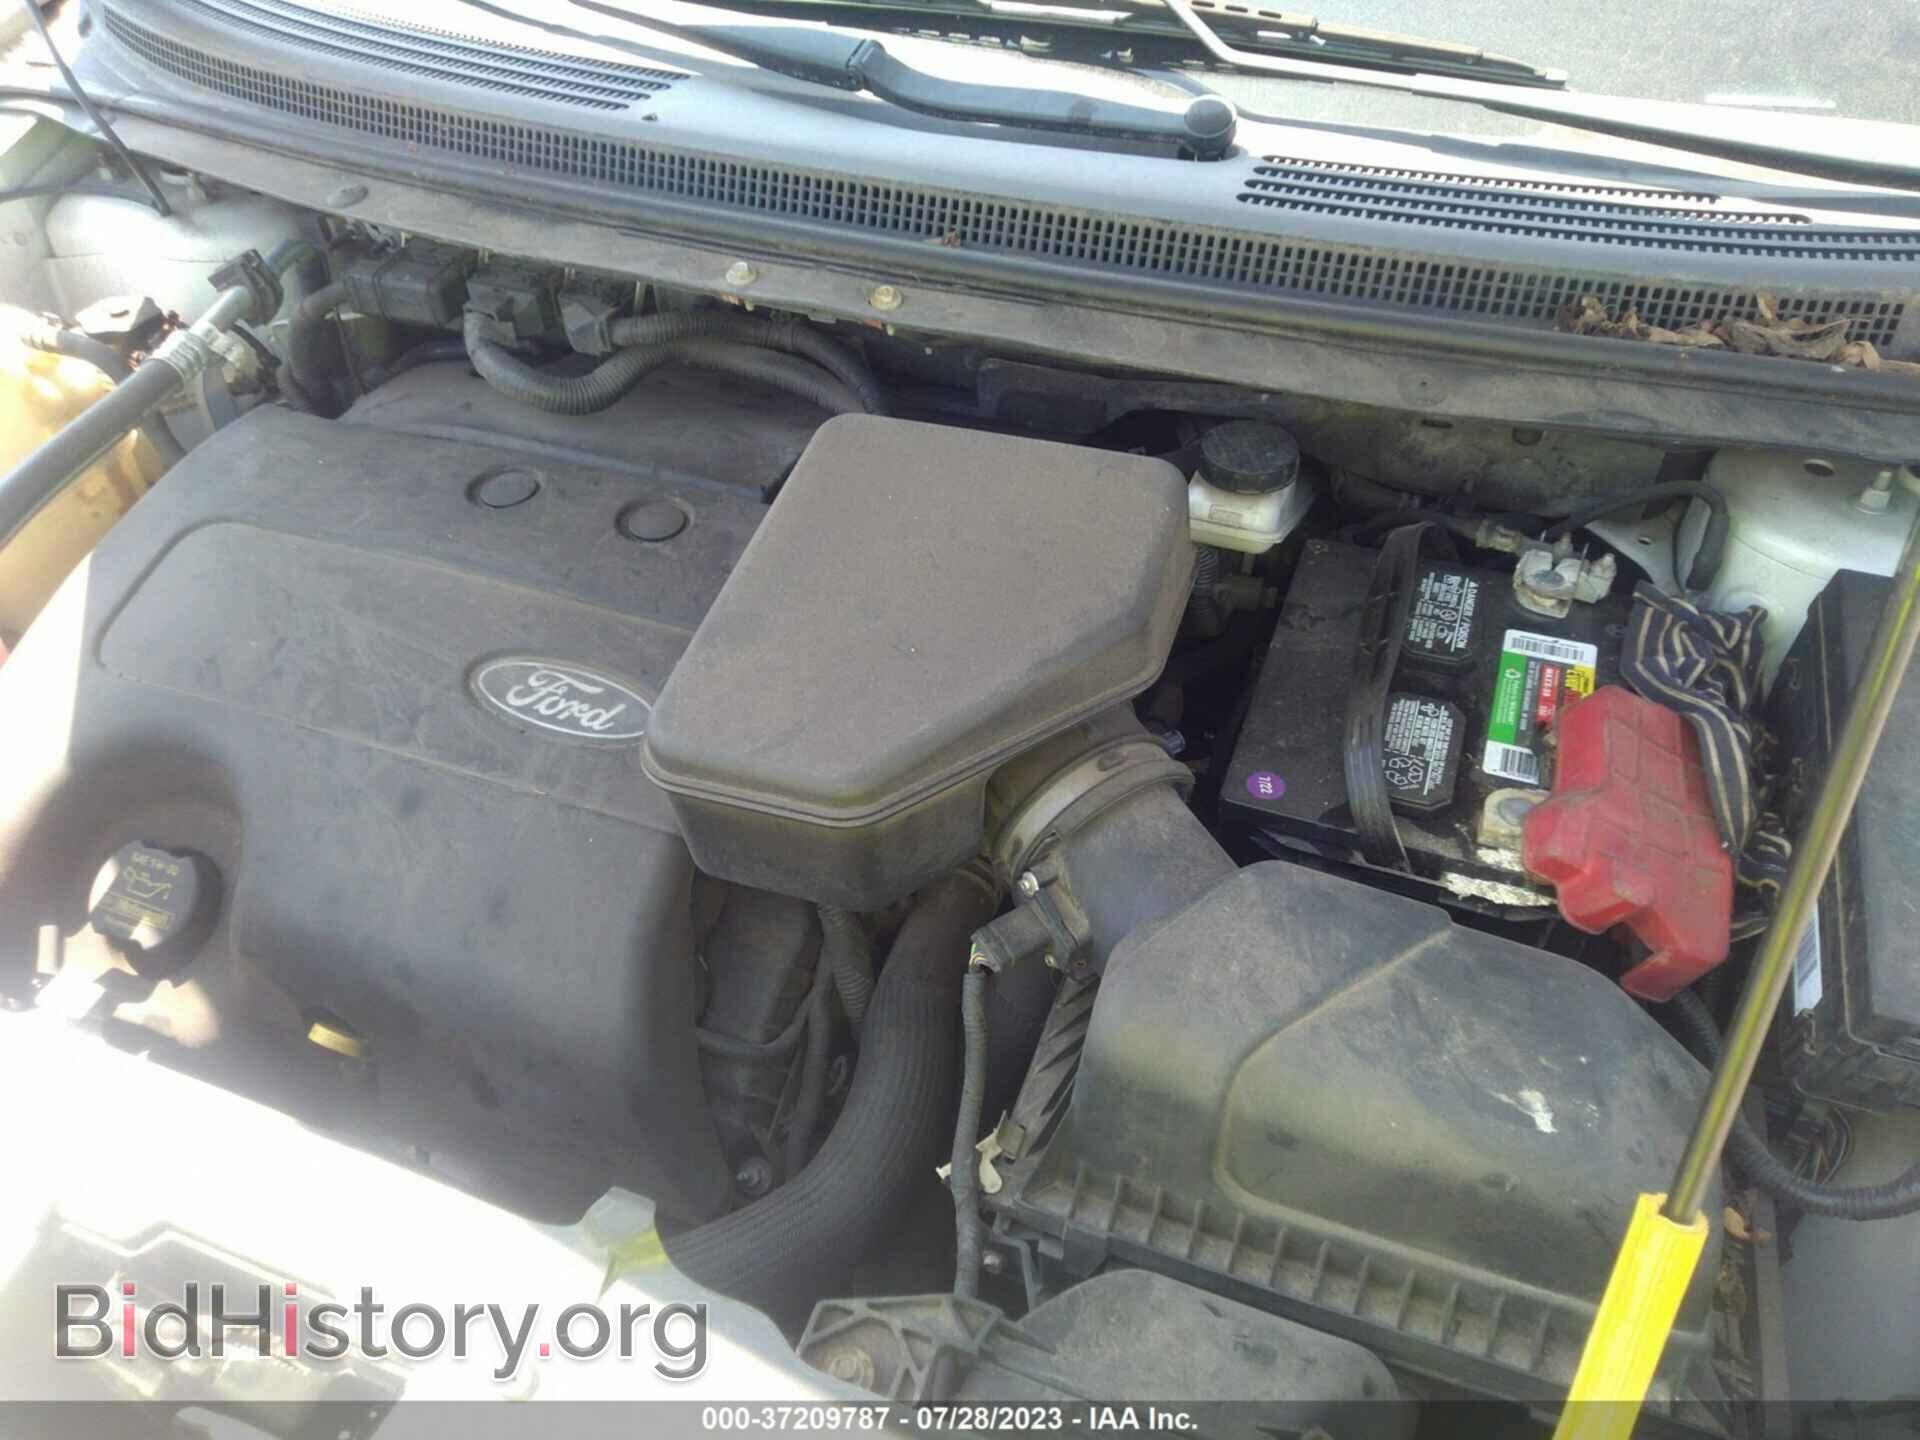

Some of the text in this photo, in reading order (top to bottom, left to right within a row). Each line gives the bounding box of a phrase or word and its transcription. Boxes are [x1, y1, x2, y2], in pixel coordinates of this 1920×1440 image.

[1463, 588, 1478, 616] DANGER
[1456, 622, 1471, 648] POISON
[506, 670, 626, 731] Ford
